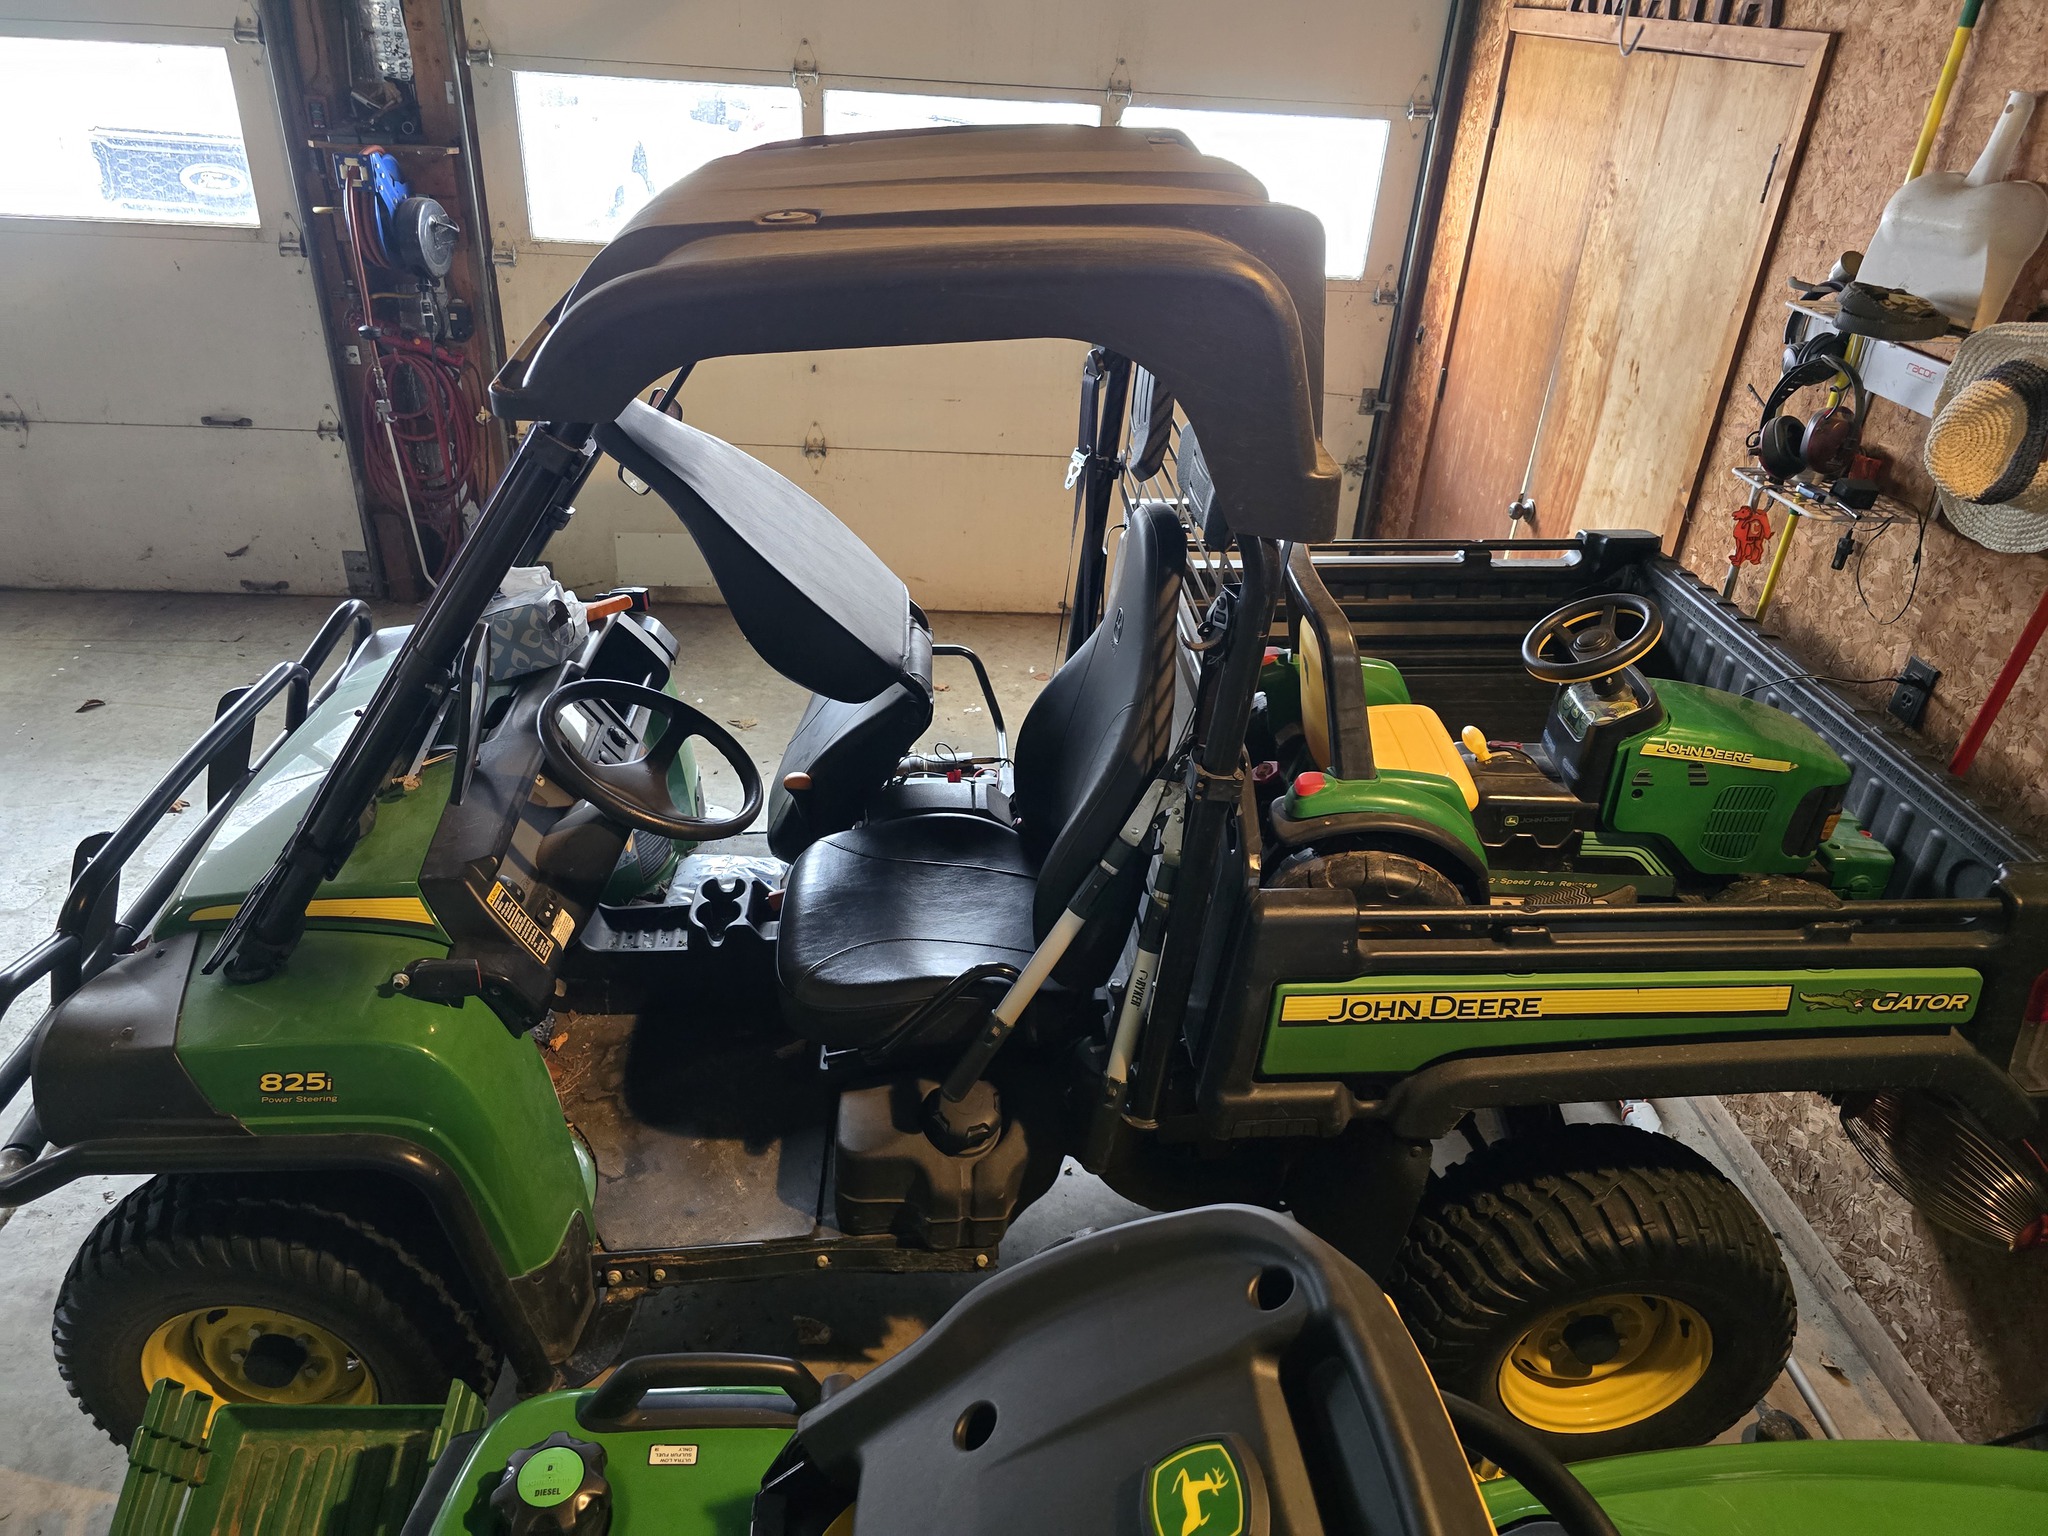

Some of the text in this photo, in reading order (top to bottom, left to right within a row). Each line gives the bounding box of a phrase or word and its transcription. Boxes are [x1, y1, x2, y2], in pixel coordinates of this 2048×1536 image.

[1657, 740, 1754, 764] JOHN DEERE
[1533, 879, 1555, 887] plus
[1327, 994, 1543, 1022] JOHN DEERE
[1871, 991, 1971, 1012] GATOR
[259, 1071, 333, 1092] 825i
[295, 1095, 338, 1103] Steering
[547, 1464, 553, 1472] D
[534, 1487, 561, 1498] DIESEL
